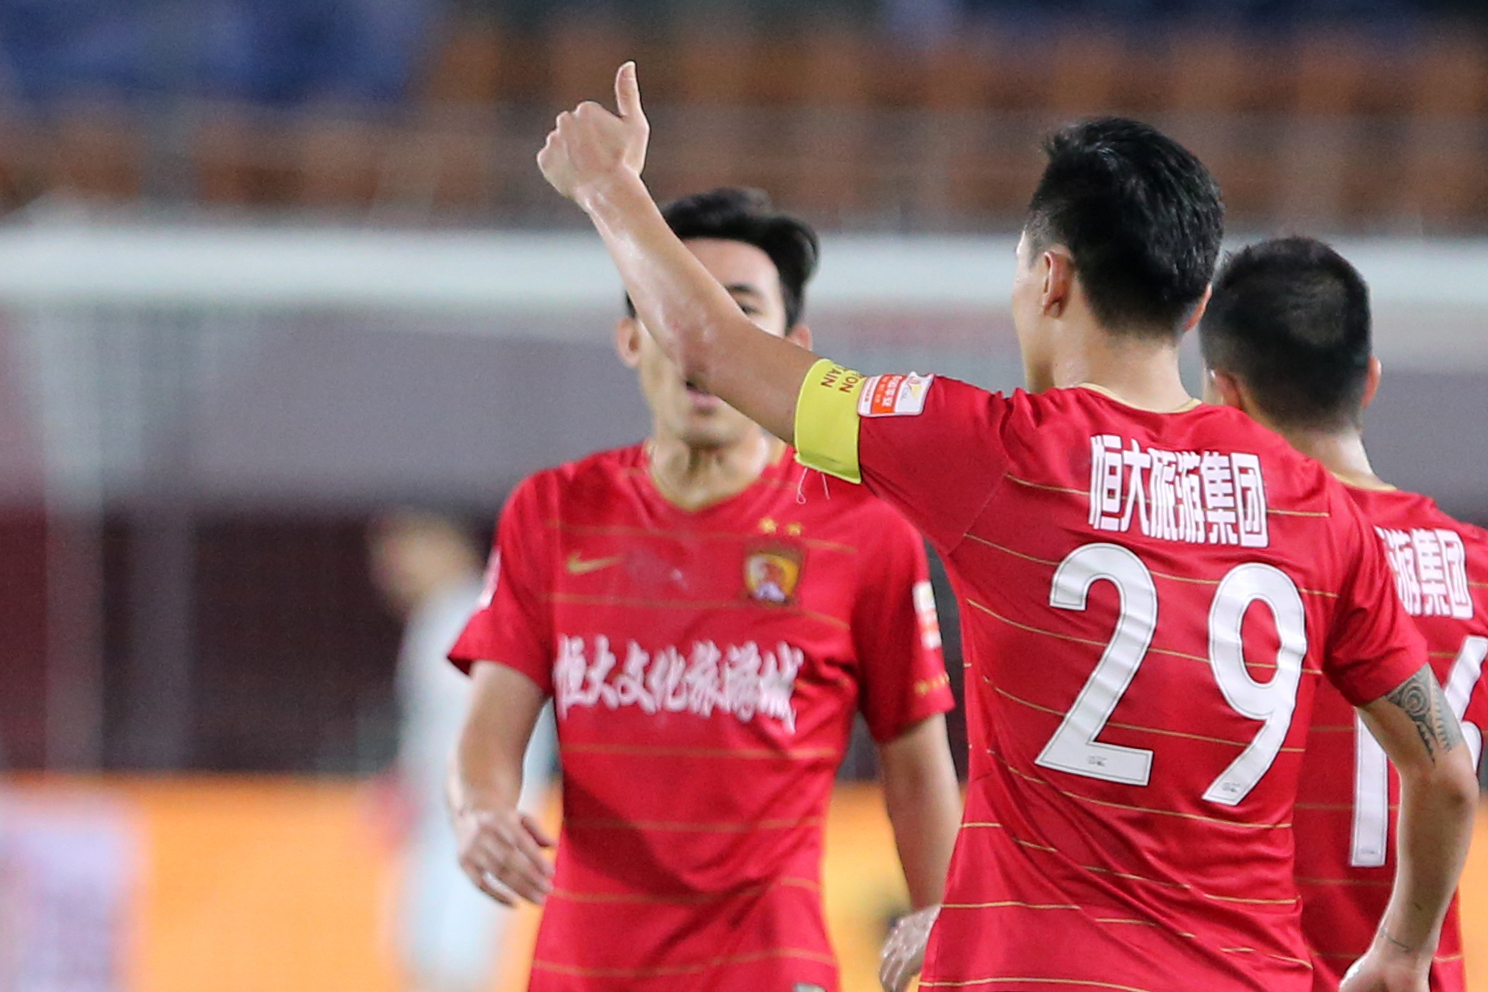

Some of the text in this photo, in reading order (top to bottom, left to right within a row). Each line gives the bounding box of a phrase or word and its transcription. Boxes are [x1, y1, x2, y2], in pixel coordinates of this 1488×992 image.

[1088, 434, 1269, 548] 恒大旅游集团
[1034, 542, 1307, 807] 29
